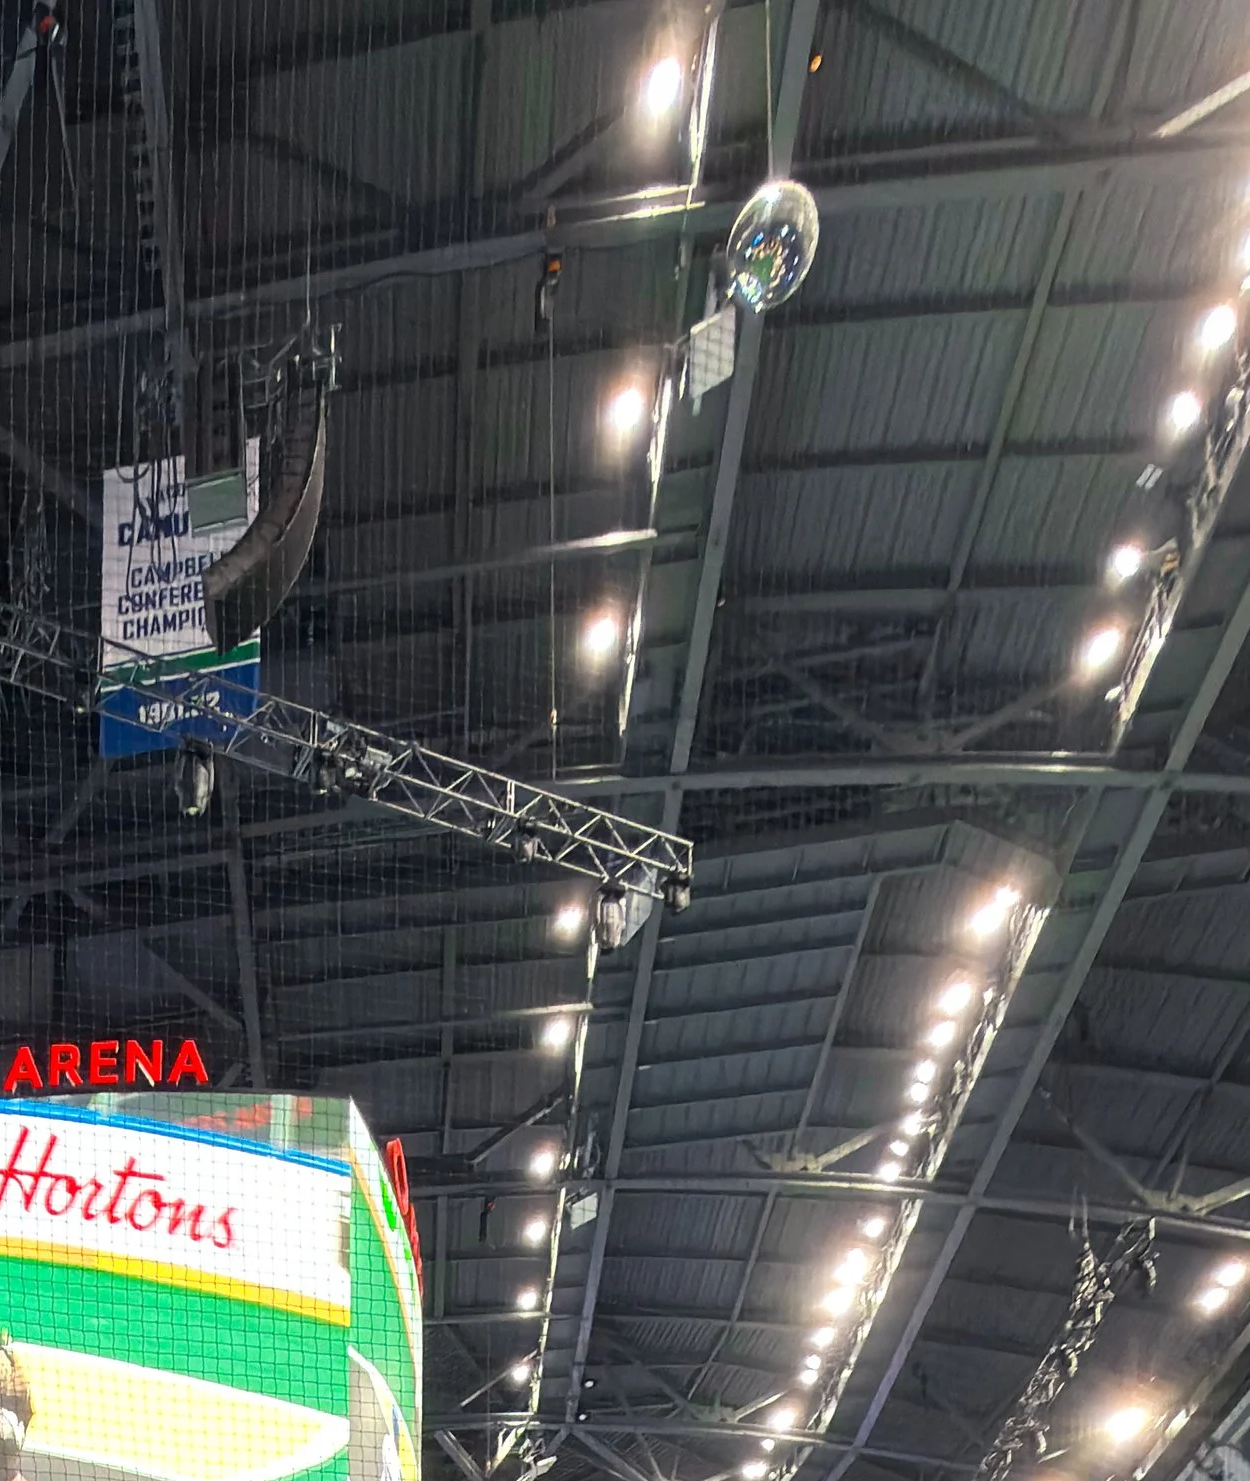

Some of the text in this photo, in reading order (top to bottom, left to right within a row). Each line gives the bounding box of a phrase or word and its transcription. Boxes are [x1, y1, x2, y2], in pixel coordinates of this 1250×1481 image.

[117, 582, 203, 615] CONFERE
[123, 607, 206, 640] CHAMPI
[5, 1039, 209, 1093] ARENA
